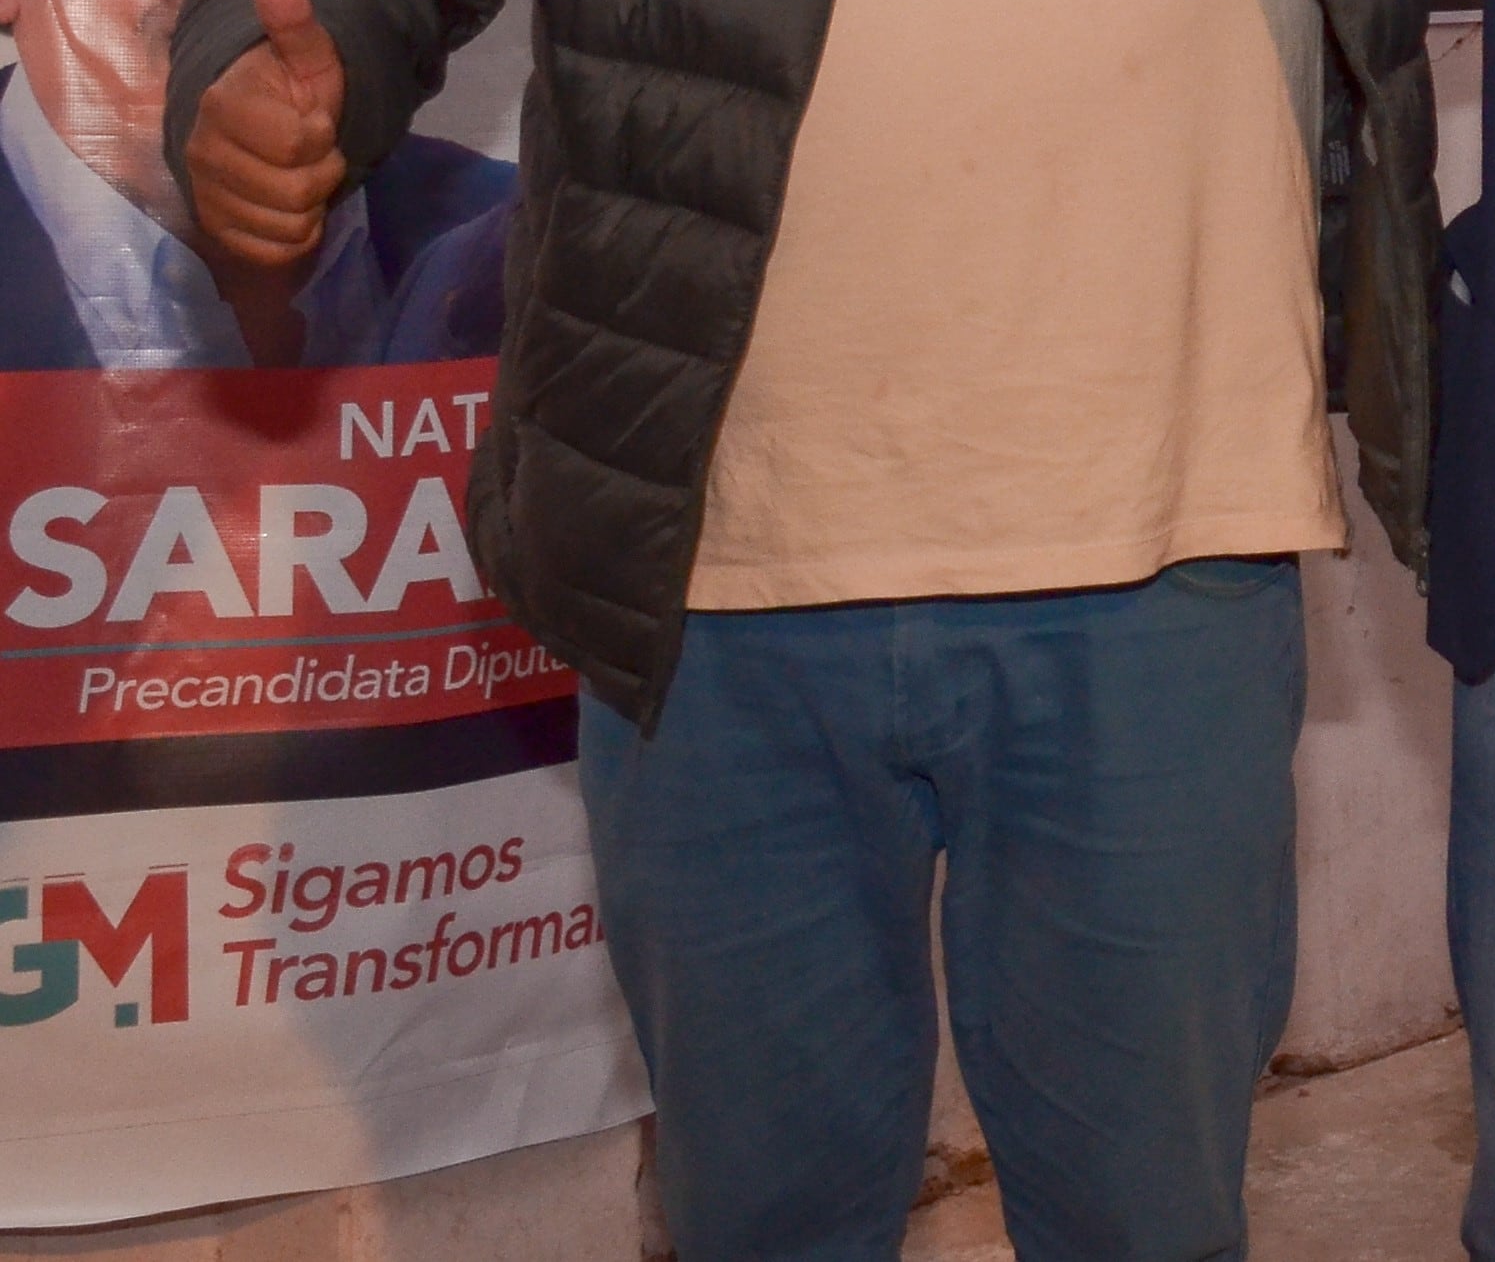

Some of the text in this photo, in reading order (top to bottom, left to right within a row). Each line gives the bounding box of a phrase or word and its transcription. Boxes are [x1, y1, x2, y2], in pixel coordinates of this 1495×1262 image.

[77, 654, 431, 714] Precandidata
[218, 836, 524, 933] Sigamos
[222, 903, 607, 1008] Transforma
